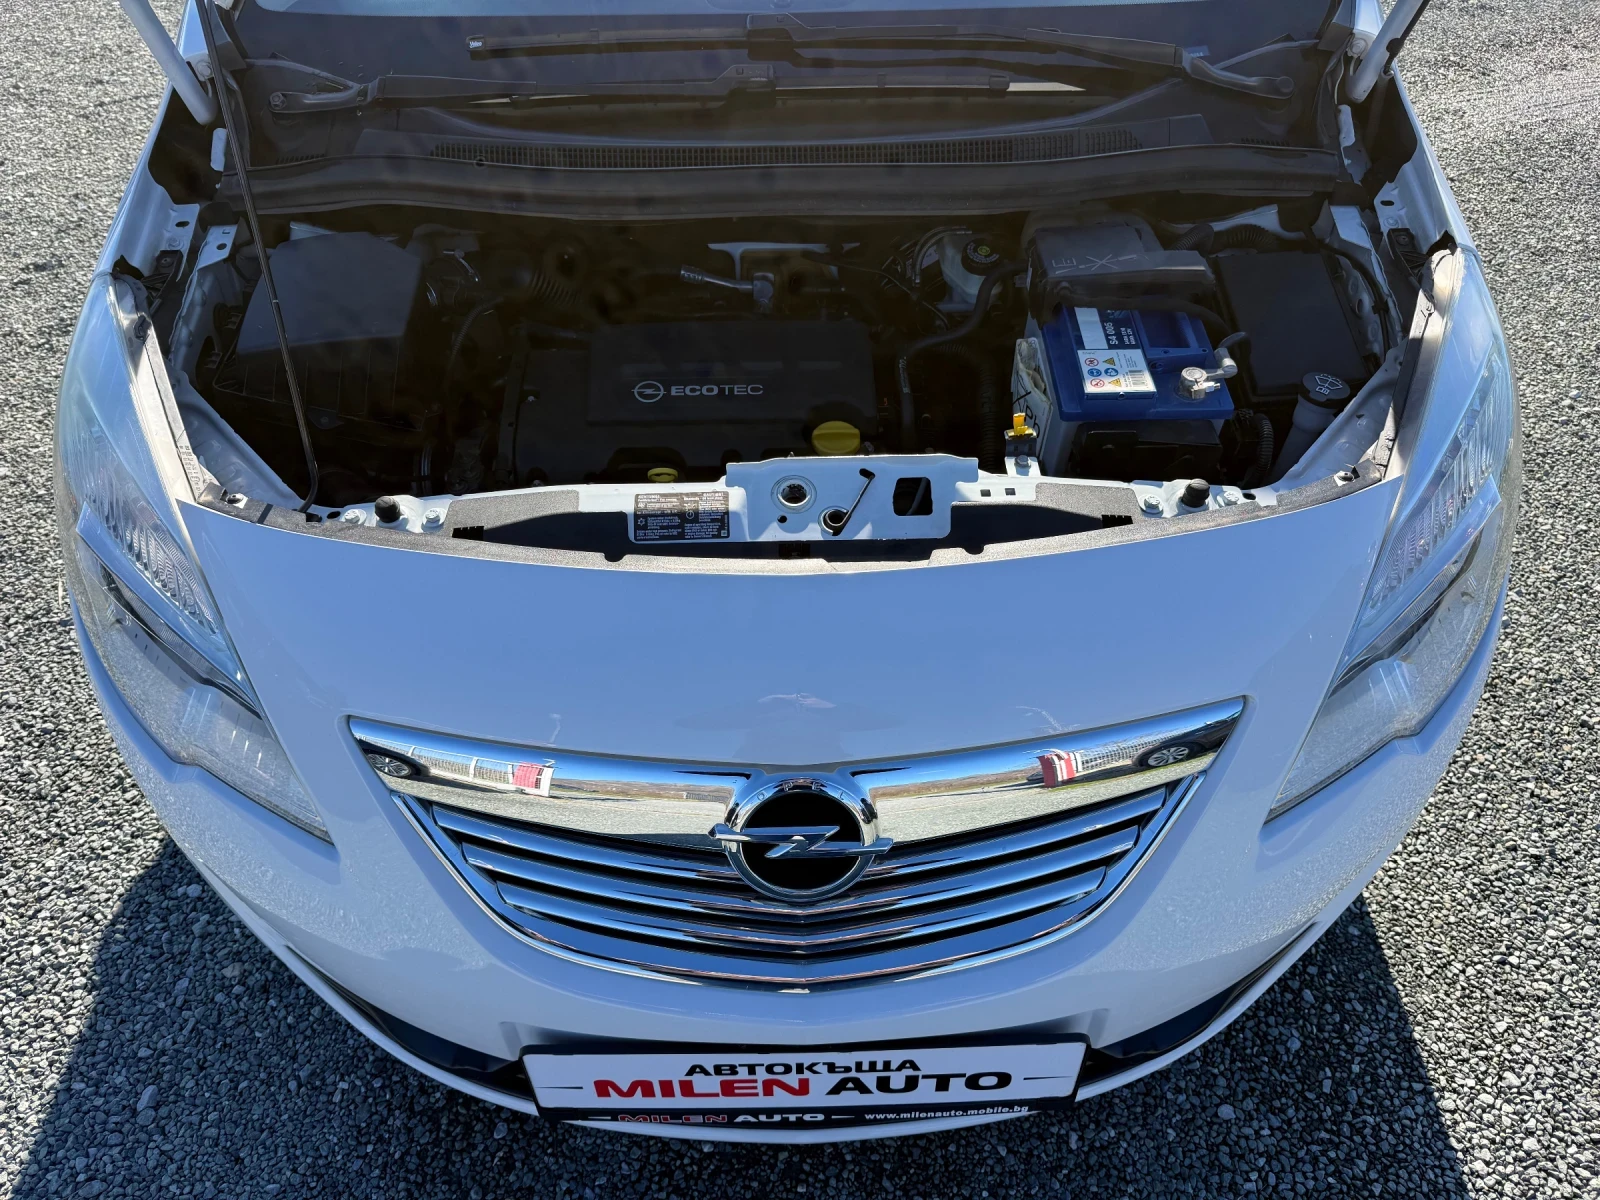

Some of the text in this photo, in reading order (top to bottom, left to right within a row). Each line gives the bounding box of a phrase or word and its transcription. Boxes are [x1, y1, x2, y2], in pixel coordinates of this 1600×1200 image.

[1109, 335, 1119, 345] S4
[670, 384, 764, 396] ECOTEC
[756, 781, 847, 801] OPEL
[593, 1072, 1012, 1098] MILEN AUTO
[618, 1113, 825, 1123] MILEN AUTO
[864, 1105, 1029, 1120] www.milenauto.mobile.bg
